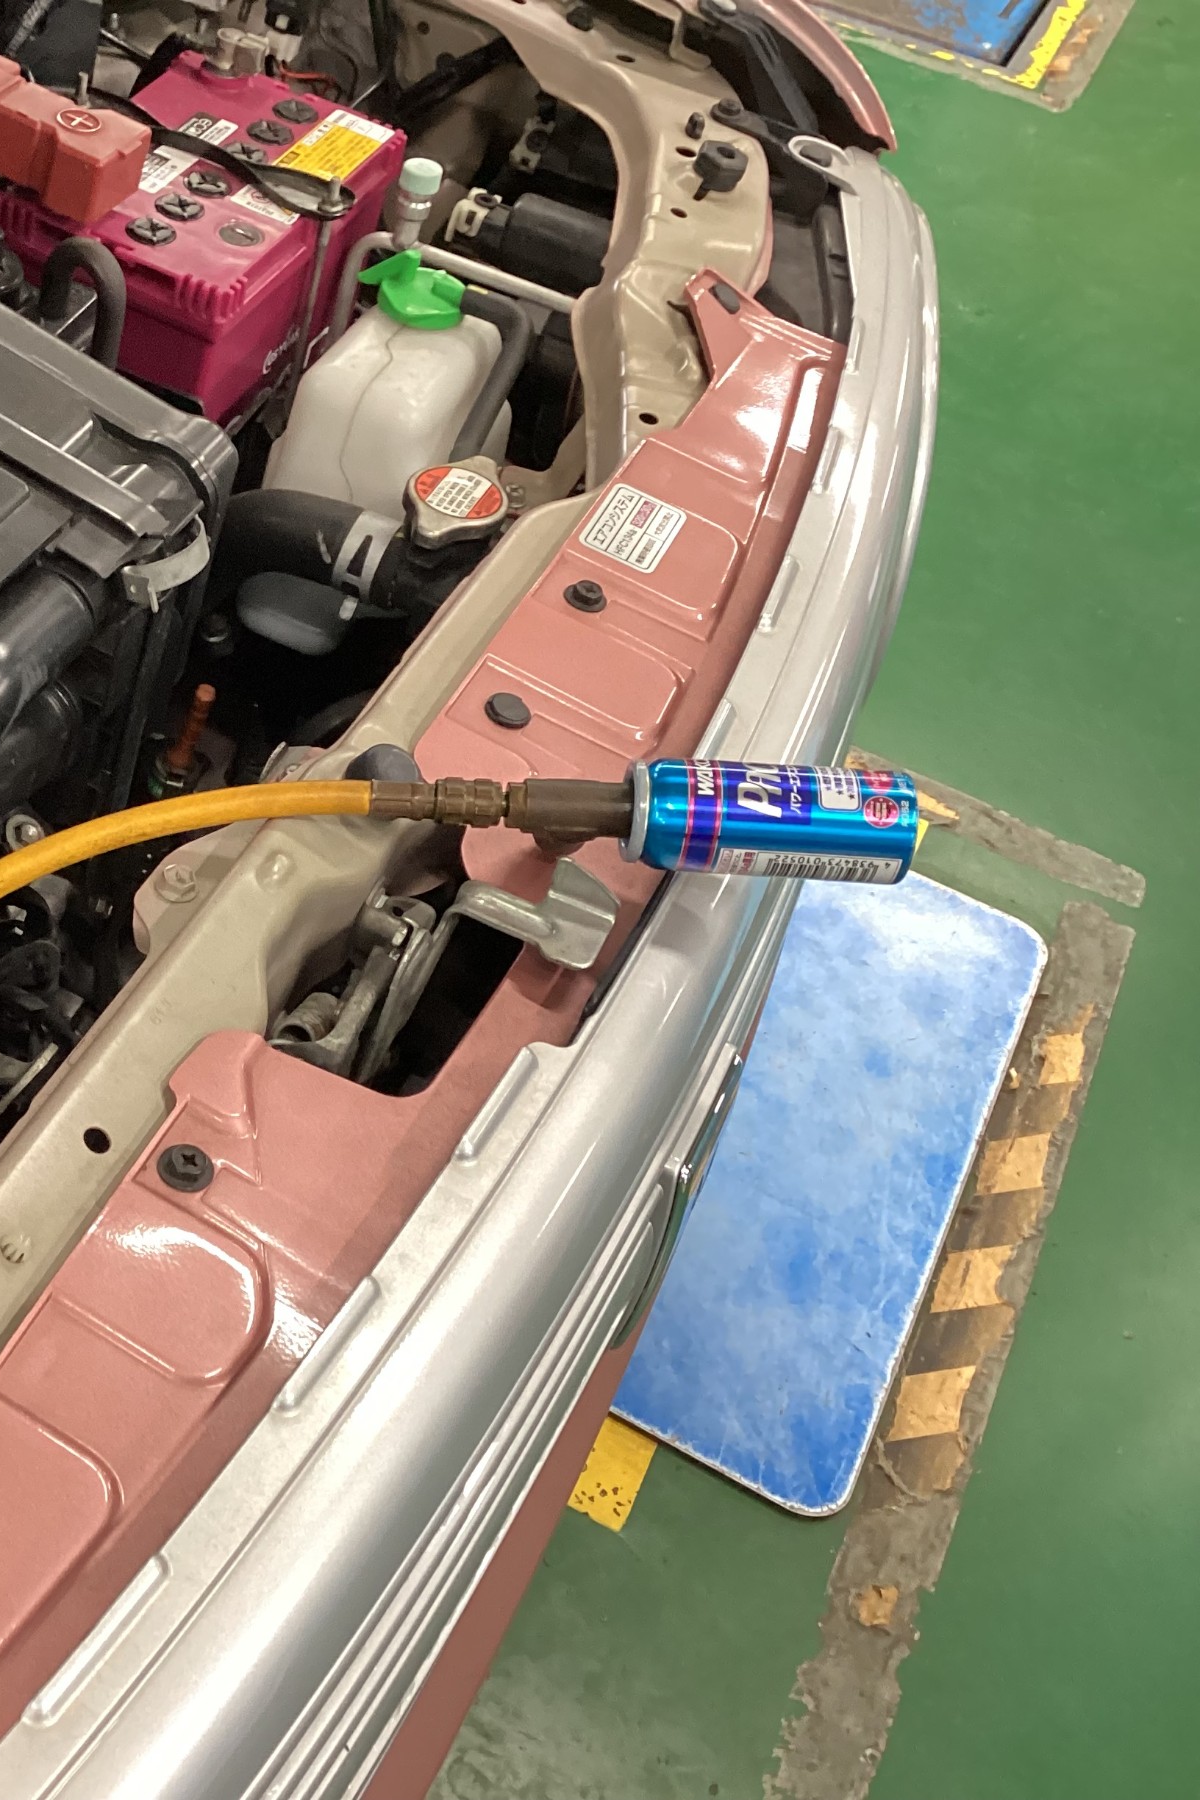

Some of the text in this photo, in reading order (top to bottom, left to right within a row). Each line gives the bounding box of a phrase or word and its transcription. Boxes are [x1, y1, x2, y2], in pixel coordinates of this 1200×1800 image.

[592, 494, 635, 545] エアコンシステム
[614, 529, 638, 556] HFC134a
[884, 861, 892, 870] 4
